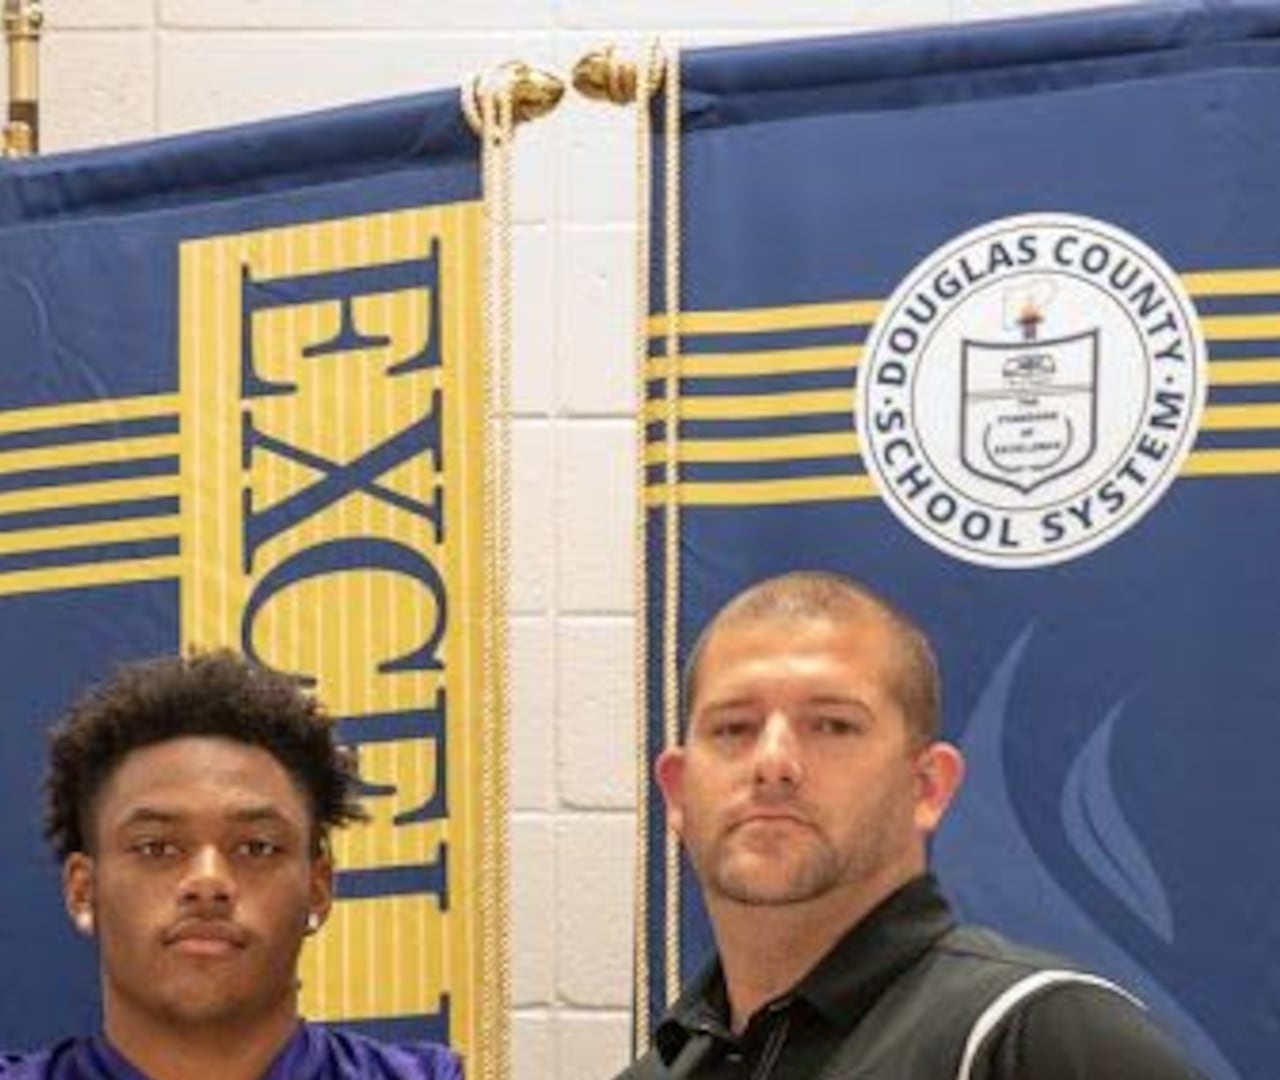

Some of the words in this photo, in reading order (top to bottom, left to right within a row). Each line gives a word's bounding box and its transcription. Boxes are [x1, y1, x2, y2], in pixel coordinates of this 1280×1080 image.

[877, 235, 1038, 388] DOUGLAS
[1052, 235, 1186, 364] COUNTY
[875, 407, 1020, 548] SCHOOL
[1040, 392, 1185, 543] SYSTEM
